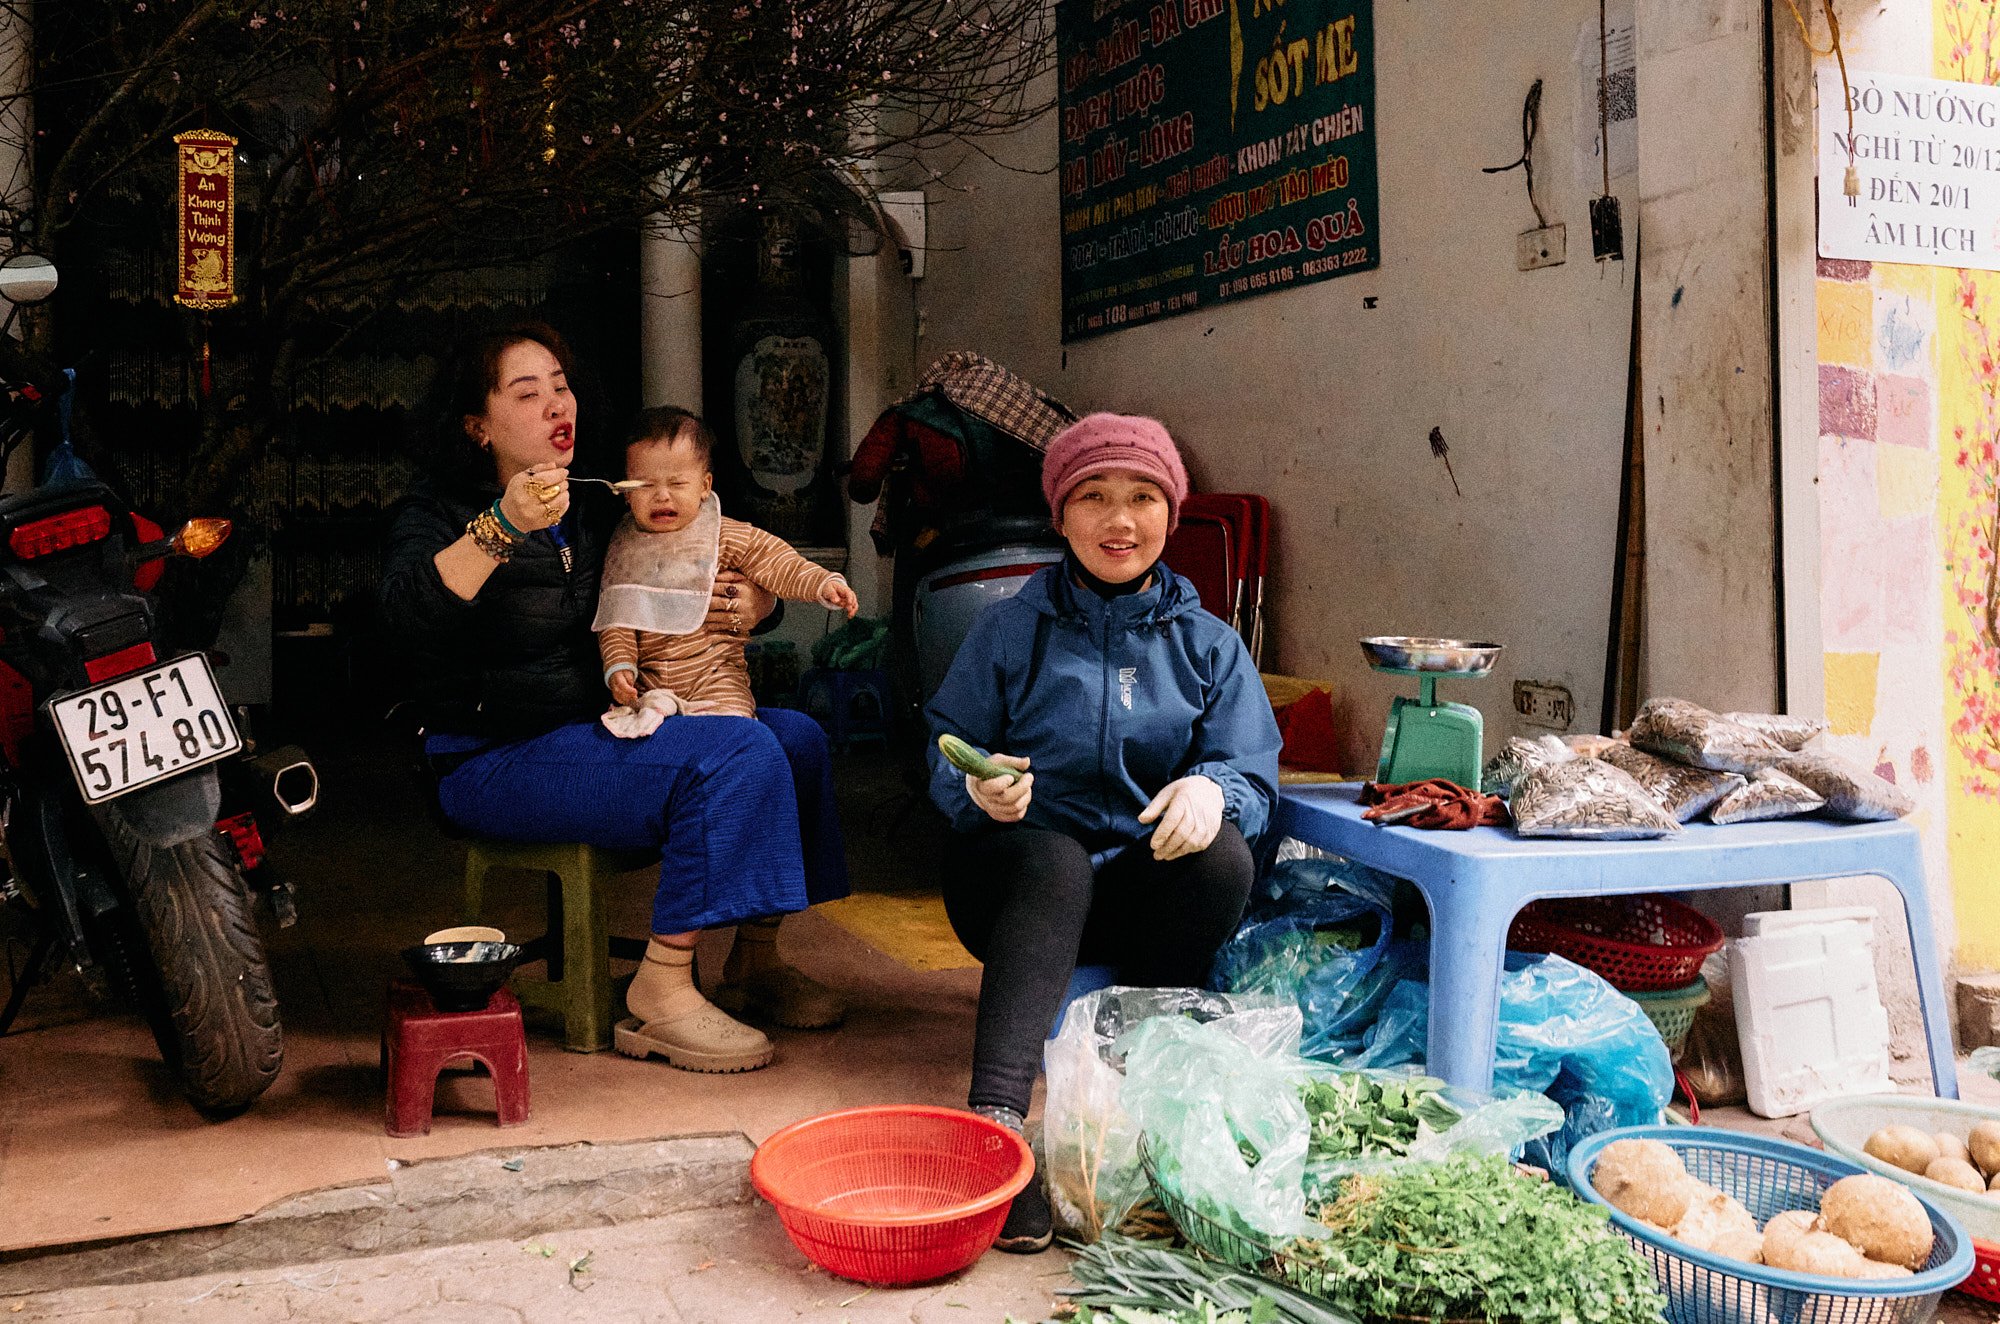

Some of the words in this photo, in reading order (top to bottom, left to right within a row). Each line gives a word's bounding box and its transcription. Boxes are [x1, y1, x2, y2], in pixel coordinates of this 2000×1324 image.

[1255, 18, 1310, 112] SỐT
[1114, 64, 1165, 121] TUỘC
[1844, 79, 1884, 115] BÒ
[1893, 88, 1996, 128] NƯỚNG
[1140, 111, 1194, 169] LÒNG
[1312, 103, 1364, 147] CHIÊN
[1832, 130, 1901, 161] NGHỈ
[1909, 134, 1946, 165] TỪ
[197, 176, 216, 192] An
[1276, 167, 1309, 206] TÁO
[1311, 153, 1349, 196] MÈO
[1870, 172, 1921, 204] ĐẾN
[1930, 183, 1971, 209] 20/1
[187, 194, 226, 213] Khang
[191, 211, 222, 229] Thịnh
[187, 228, 226, 248] Vượng
[1247, 225, 1302, 264] HOA
[1306, 197, 1365, 251] QUẢ
[1865, 213, 1905, 246] ÂM
[1915, 224, 1976, 256] LỊCH
[1342, 247, 1368, 267] 2222
[1105, 303, 1127, 325] 108
[77, 667, 194, 742] 29-F1
[80, 709, 227, 792] 574.80
